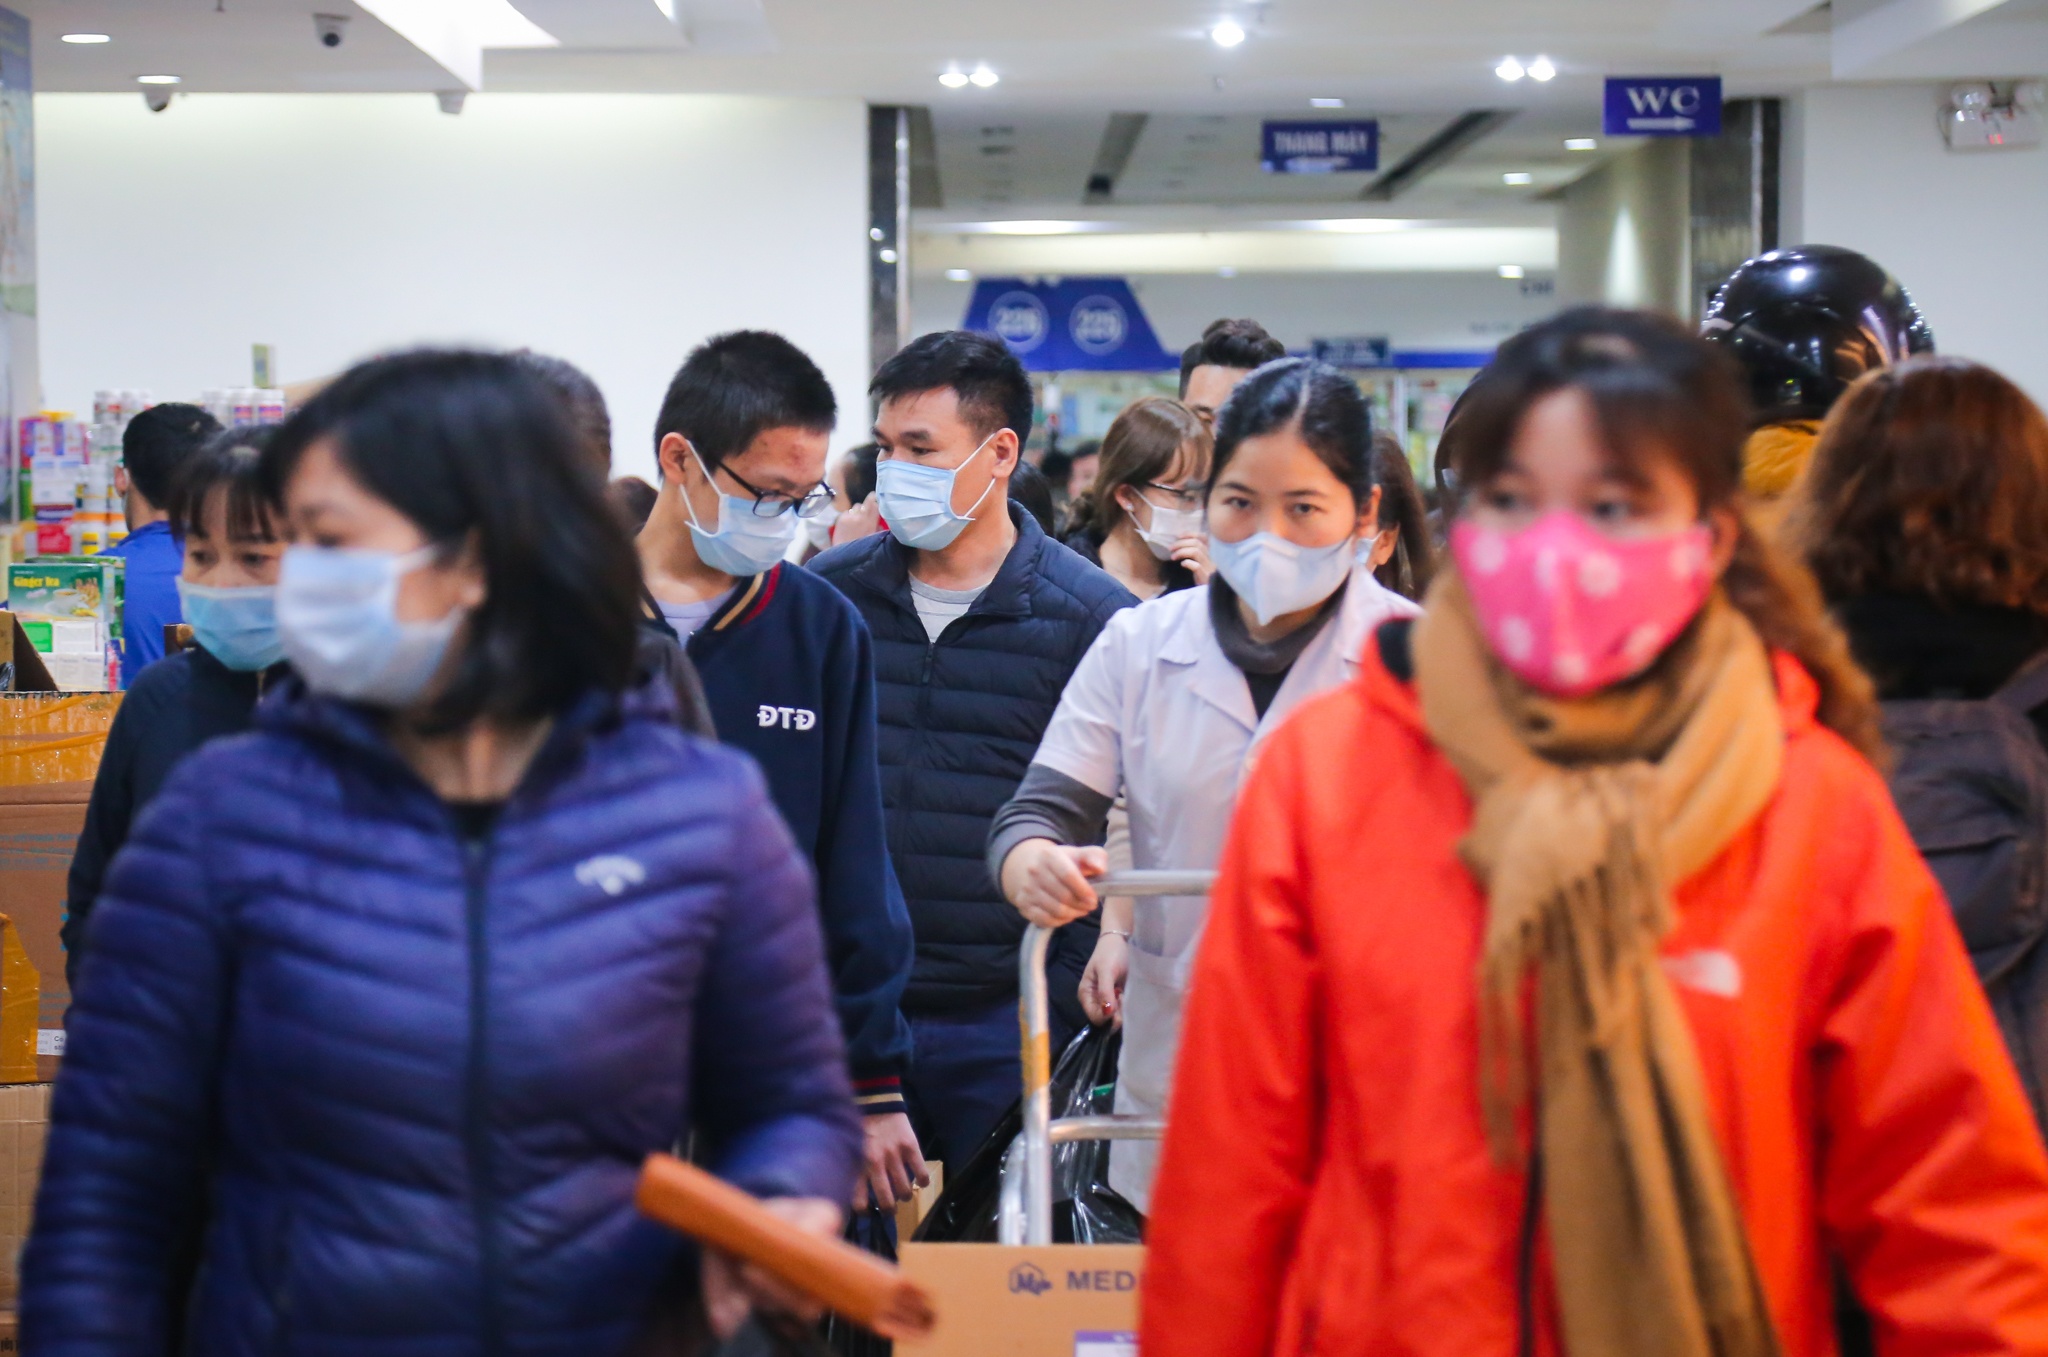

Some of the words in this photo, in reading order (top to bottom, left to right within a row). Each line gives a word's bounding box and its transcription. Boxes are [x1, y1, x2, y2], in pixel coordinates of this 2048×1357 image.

[1625, 85, 1701, 115] WC
[13, 576, 43, 588] Ginger
[757, 705, 817, 731] ĐTĐ
